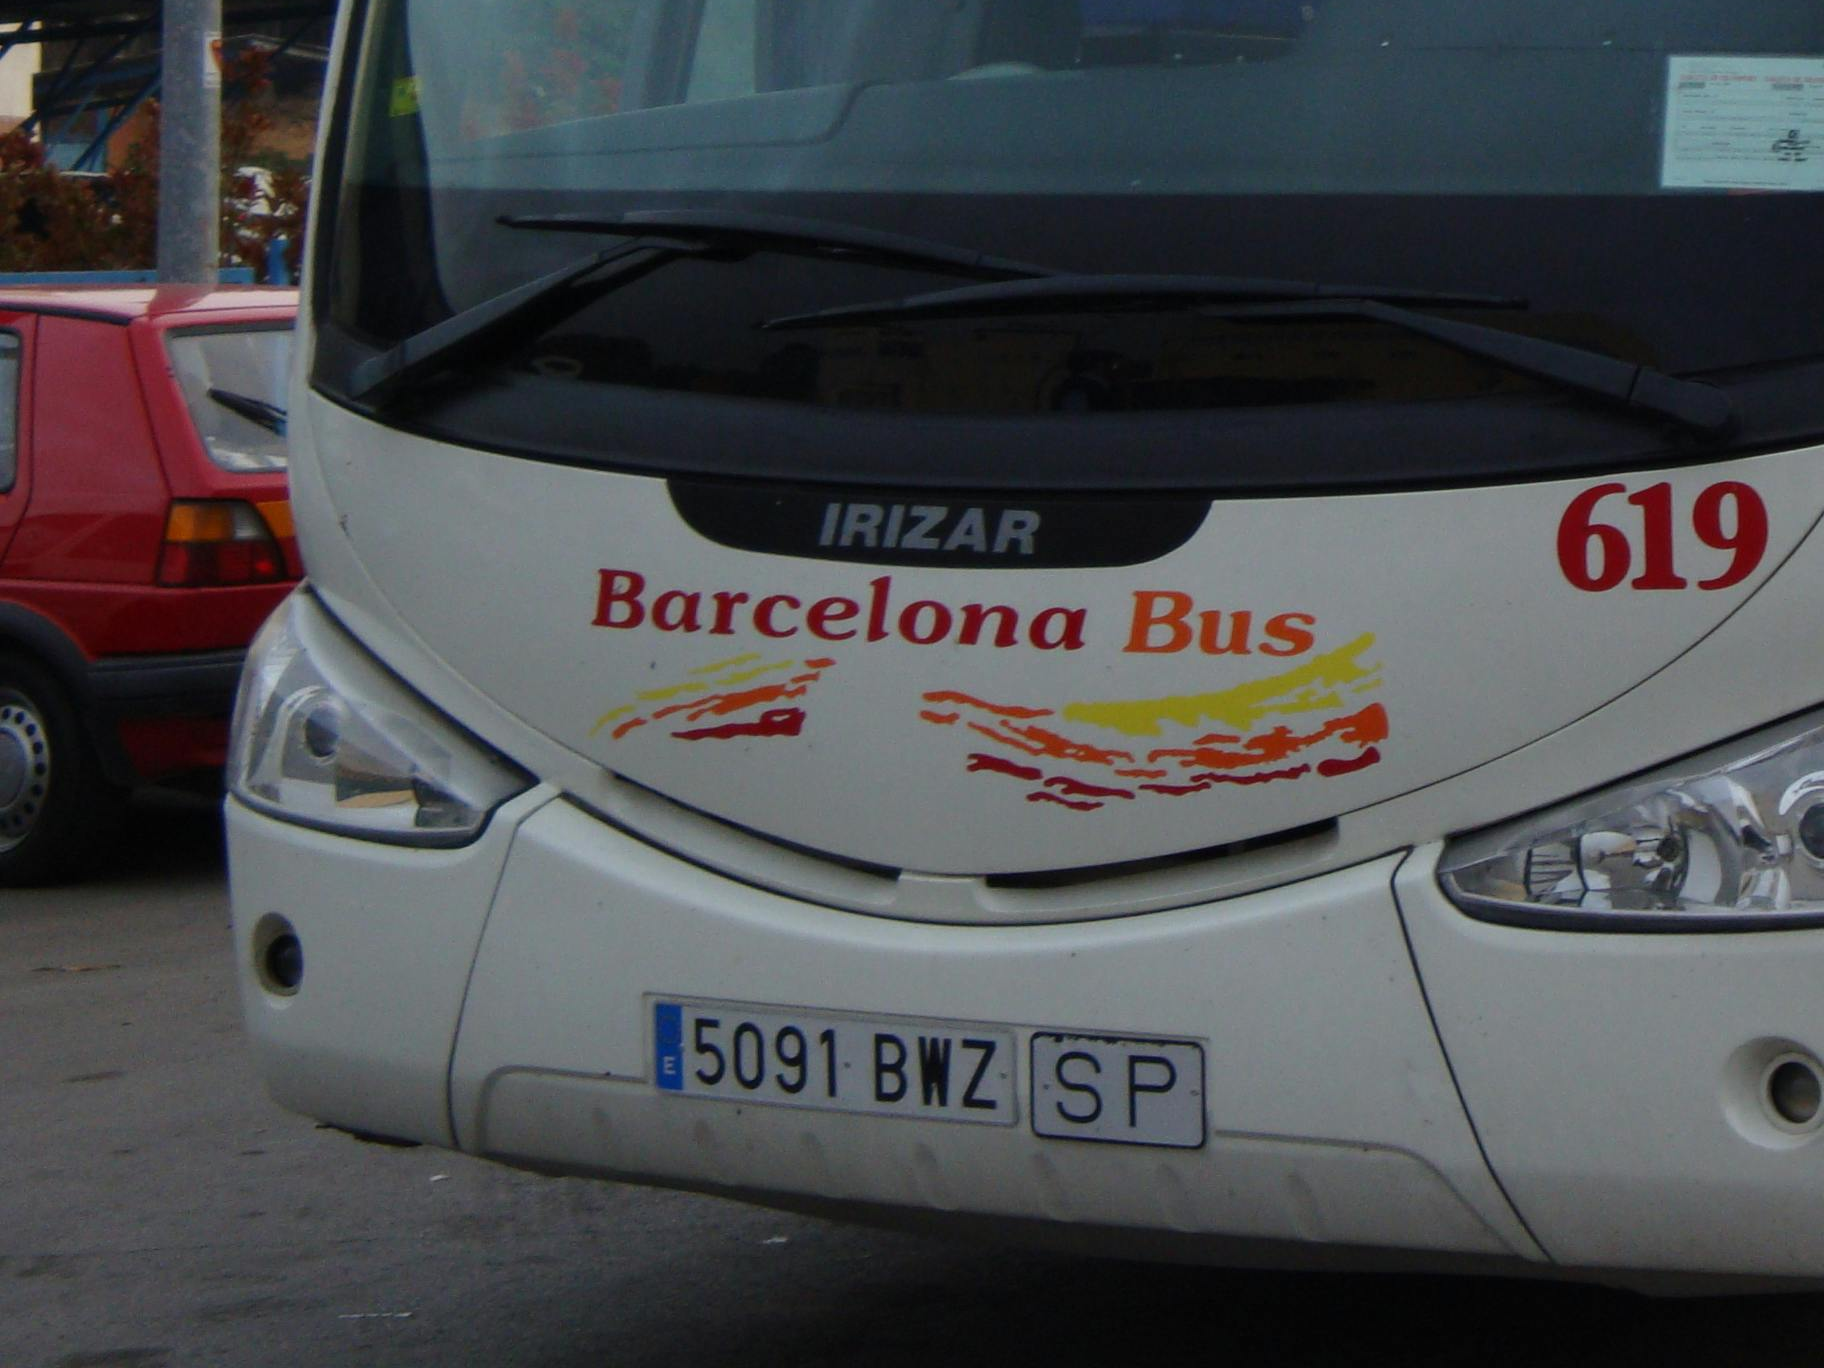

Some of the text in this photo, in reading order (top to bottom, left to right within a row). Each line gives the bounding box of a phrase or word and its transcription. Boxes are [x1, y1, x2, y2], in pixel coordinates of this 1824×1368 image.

[819, 501, 1041, 555] IRIZAR
[1557, 481, 1769, 592] 619
[590, 568, 1317, 657] Barcelona Bus
[695, 1018, 997, 1110] 5091 BWZ
[1055, 1051, 1177, 1129] SP
